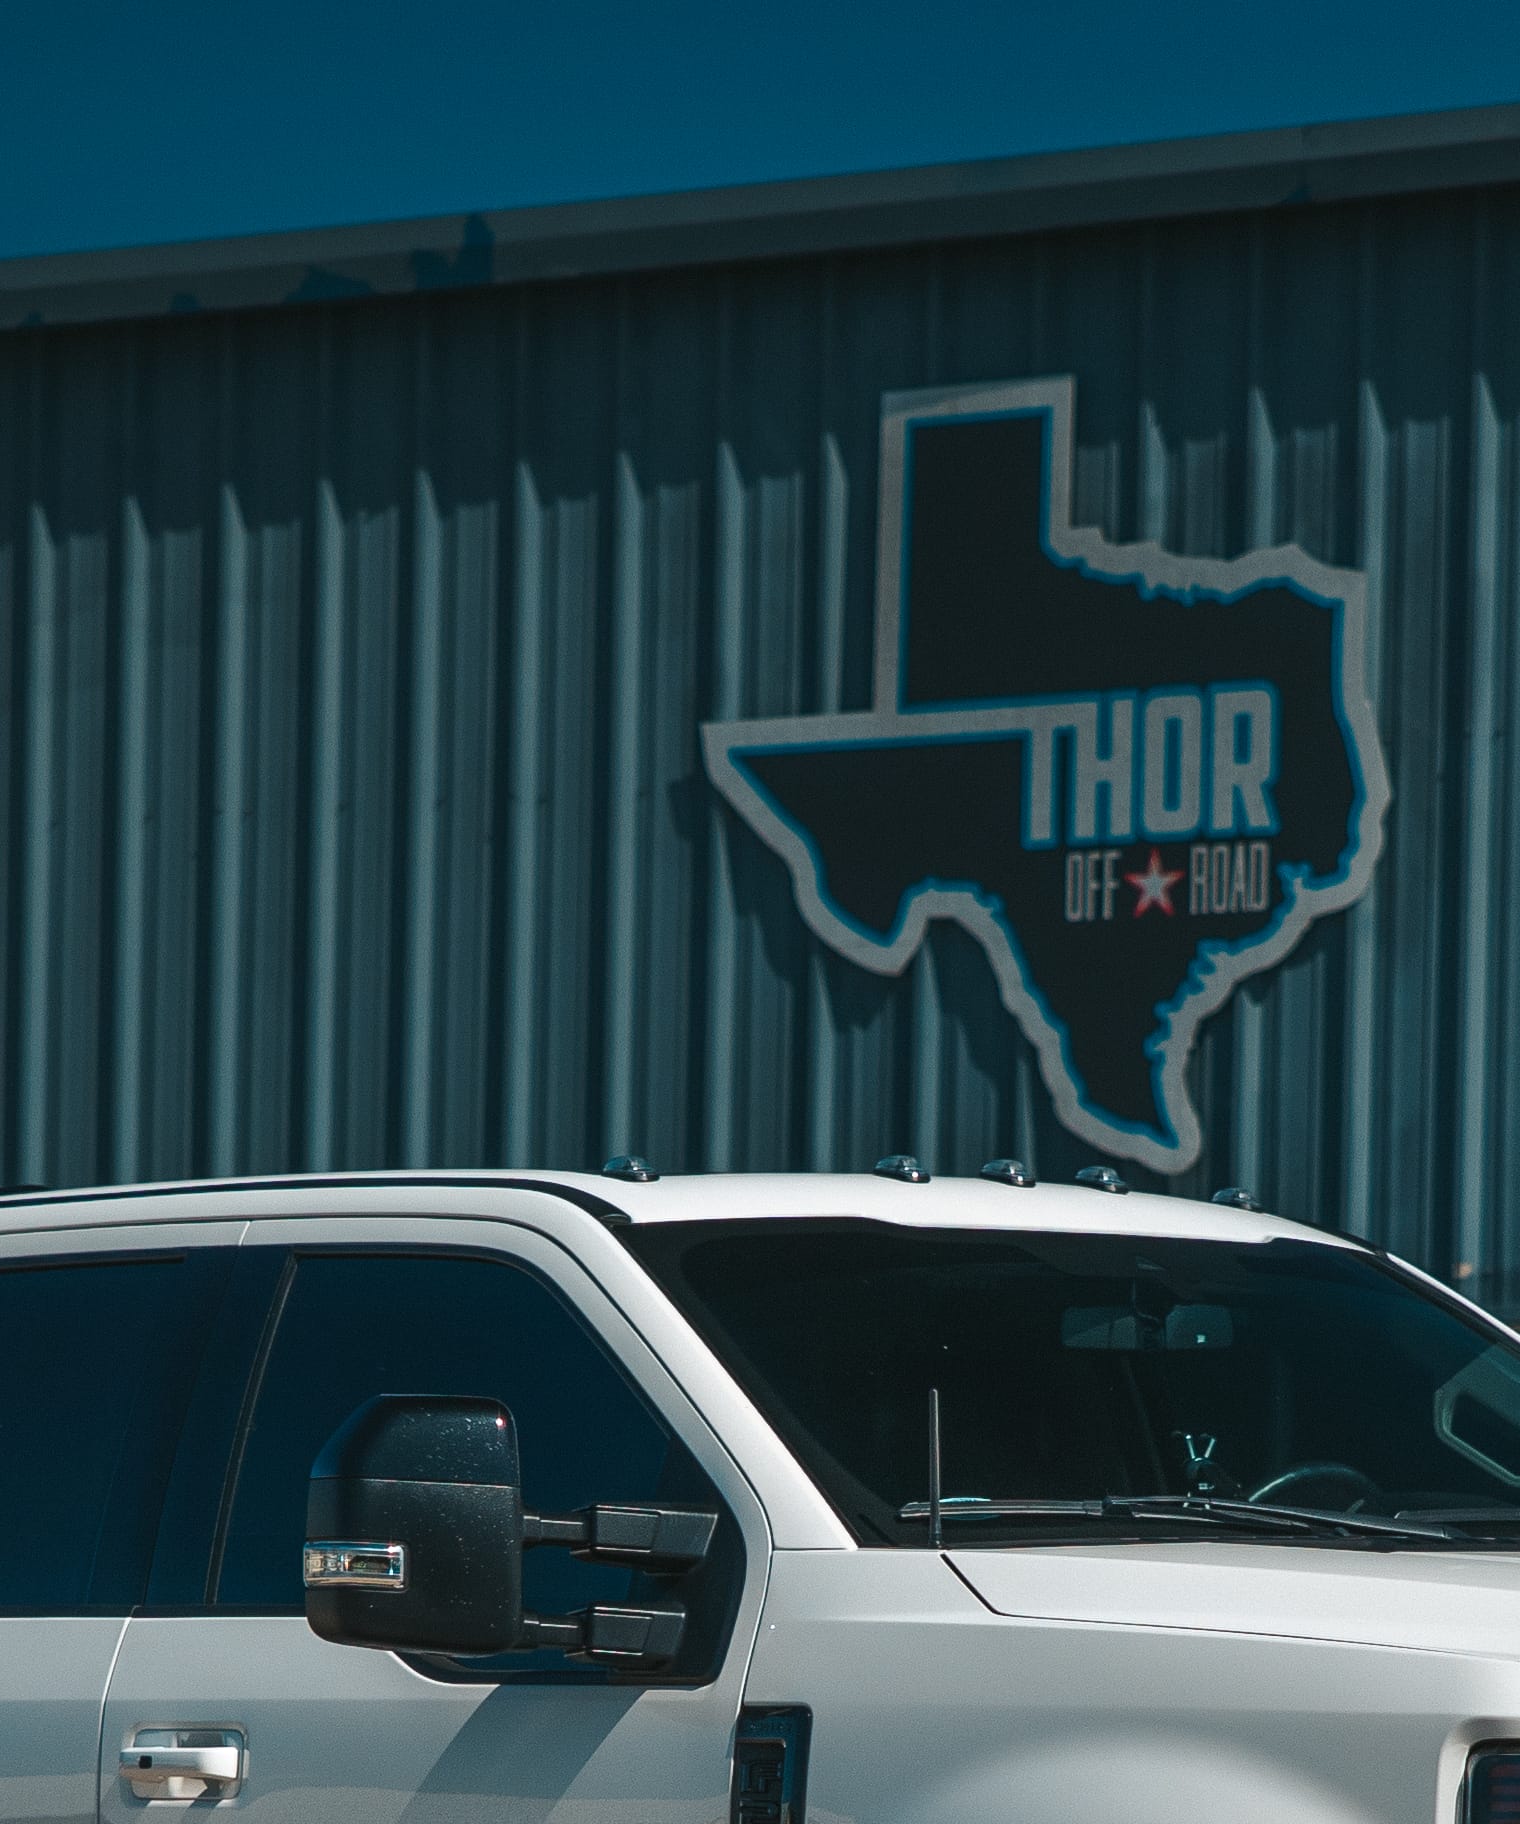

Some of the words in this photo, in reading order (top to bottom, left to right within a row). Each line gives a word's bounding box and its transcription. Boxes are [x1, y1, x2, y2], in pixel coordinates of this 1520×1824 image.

[1016, 686, 1280, 850] THOR
[1063, 848, 1121, 924] OFF
[1188, 840, 1271, 916] ROAD
